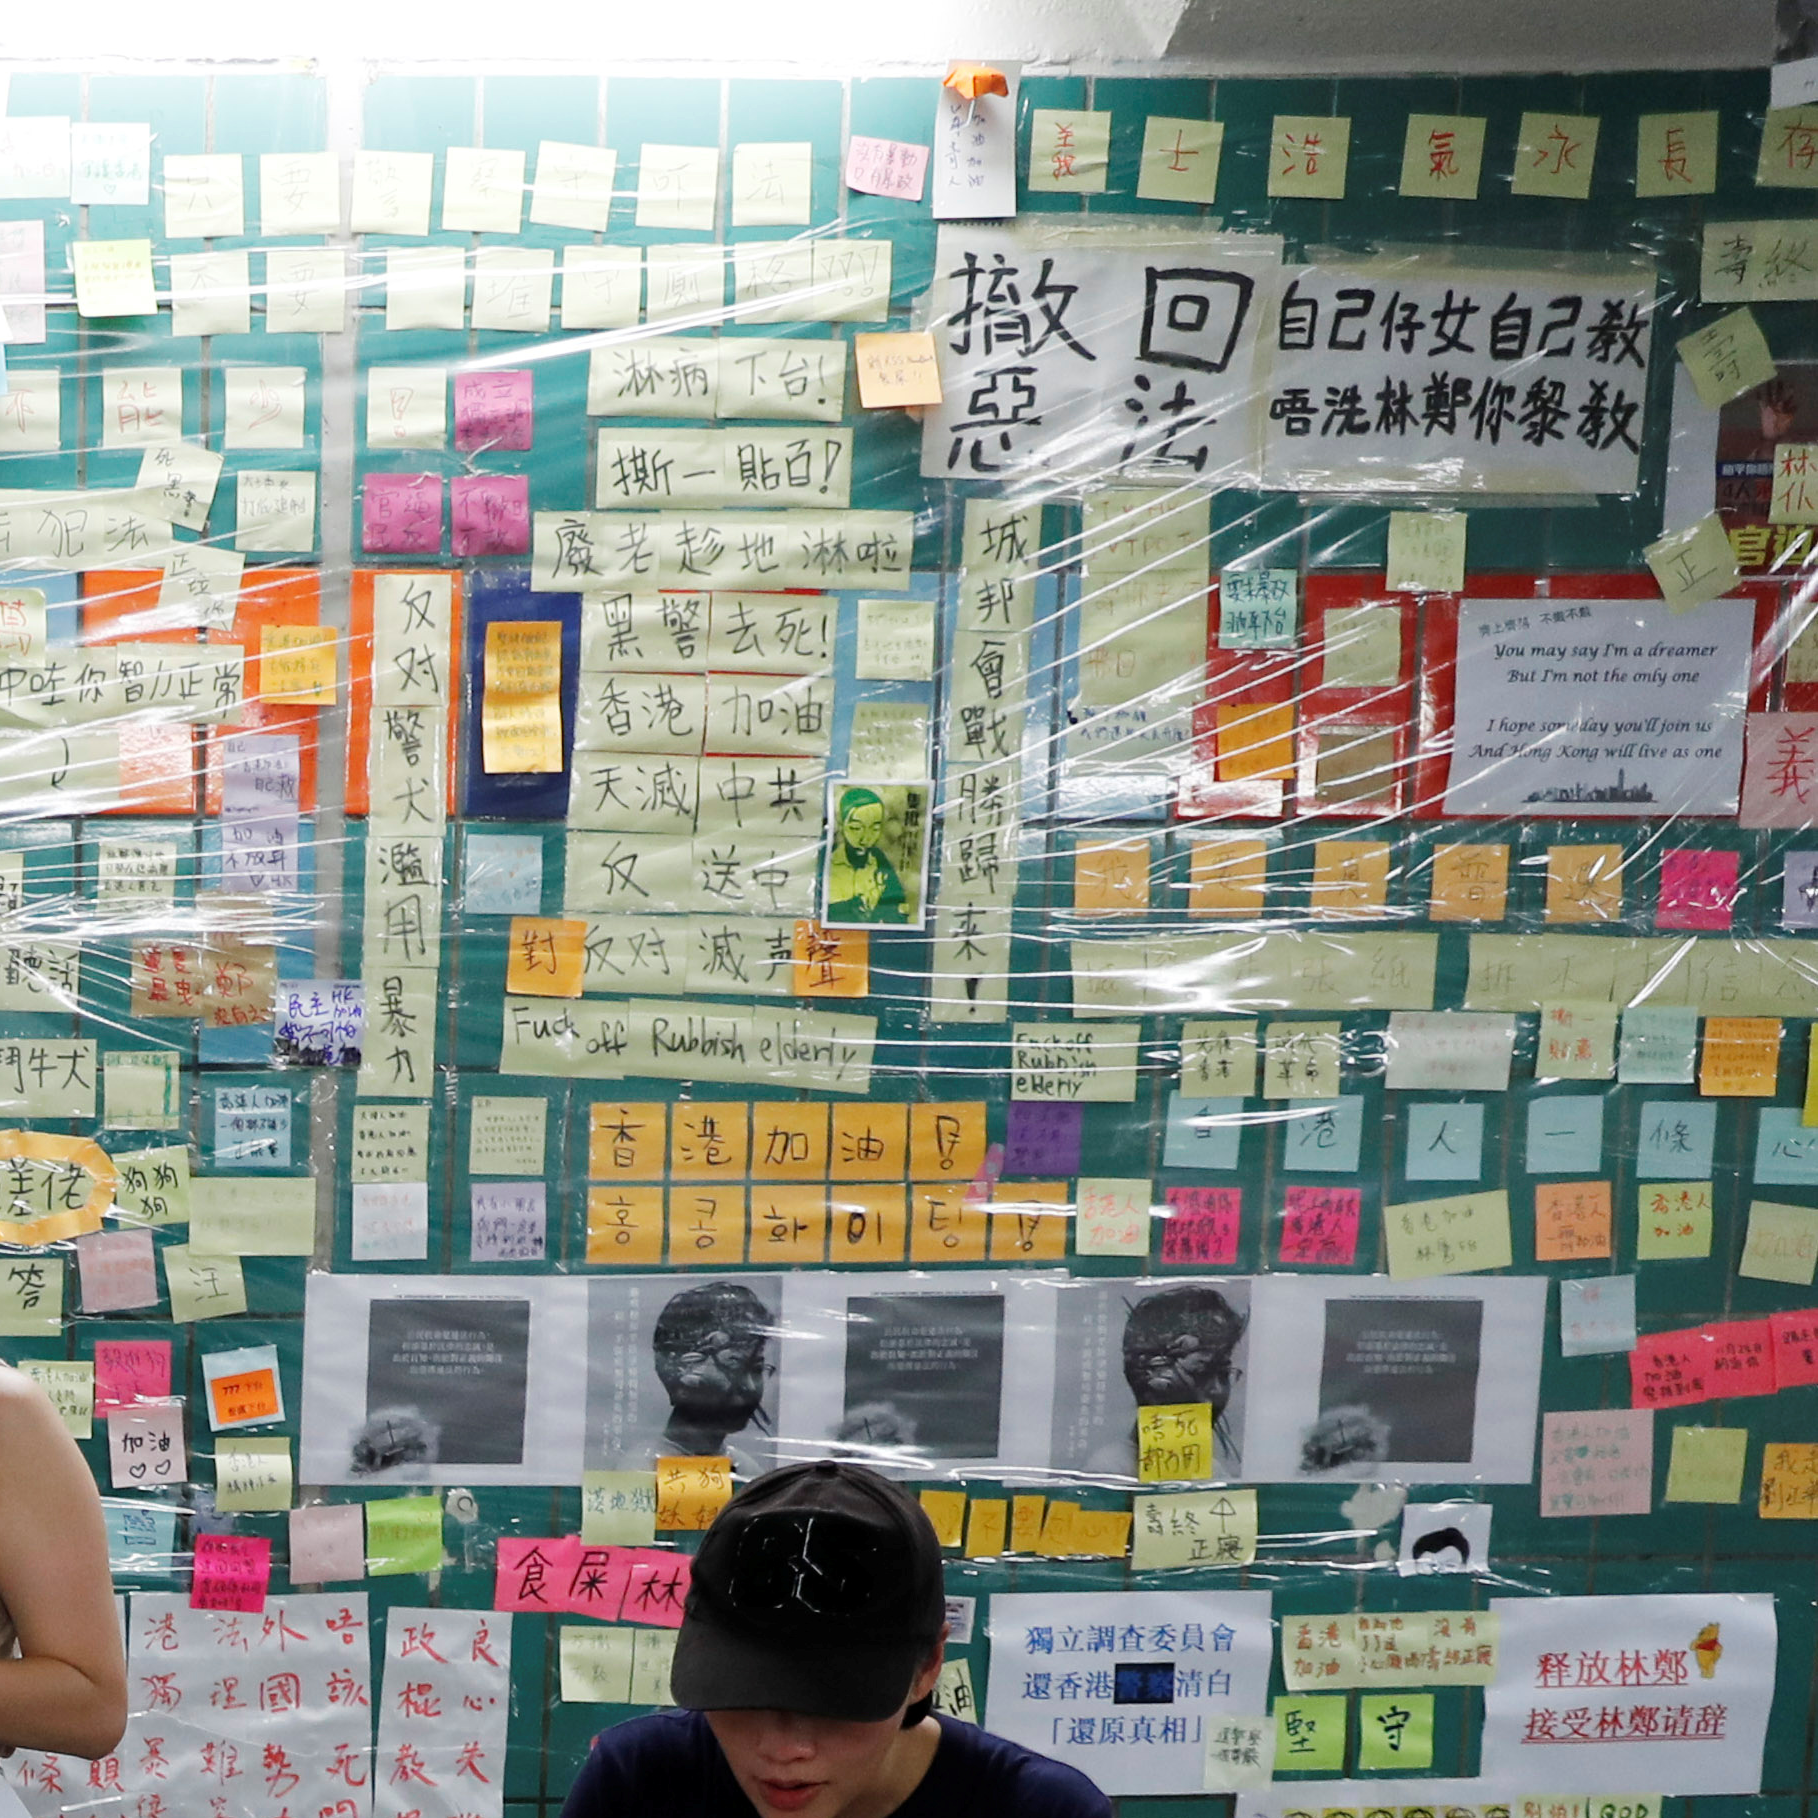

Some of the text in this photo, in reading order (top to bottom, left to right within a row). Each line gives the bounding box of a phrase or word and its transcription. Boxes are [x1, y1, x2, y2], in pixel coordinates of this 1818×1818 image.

[950, 252, 1252, 372] 撤回
[1494, 643, 1719, 660] You may say I'm a dreamer
[1508, 669, 1700, 687] But I'm not the only one
[1486, 719, 1496, 733] I
[1499, 719, 1535, 736] hope
[1614, 718, 1658, 737] you'll
[1659, 719, 1690, 737] join
[1696, 721, 1712, 733] us
[1469, 744, 1722, 763] And Hong Kong will live as one
[513, 1007, 581, 1045] Fuck
[652, 1017, 747, 1064] Rubbish
[1024, 1622, 1238, 1656] 獨立調查委員會
